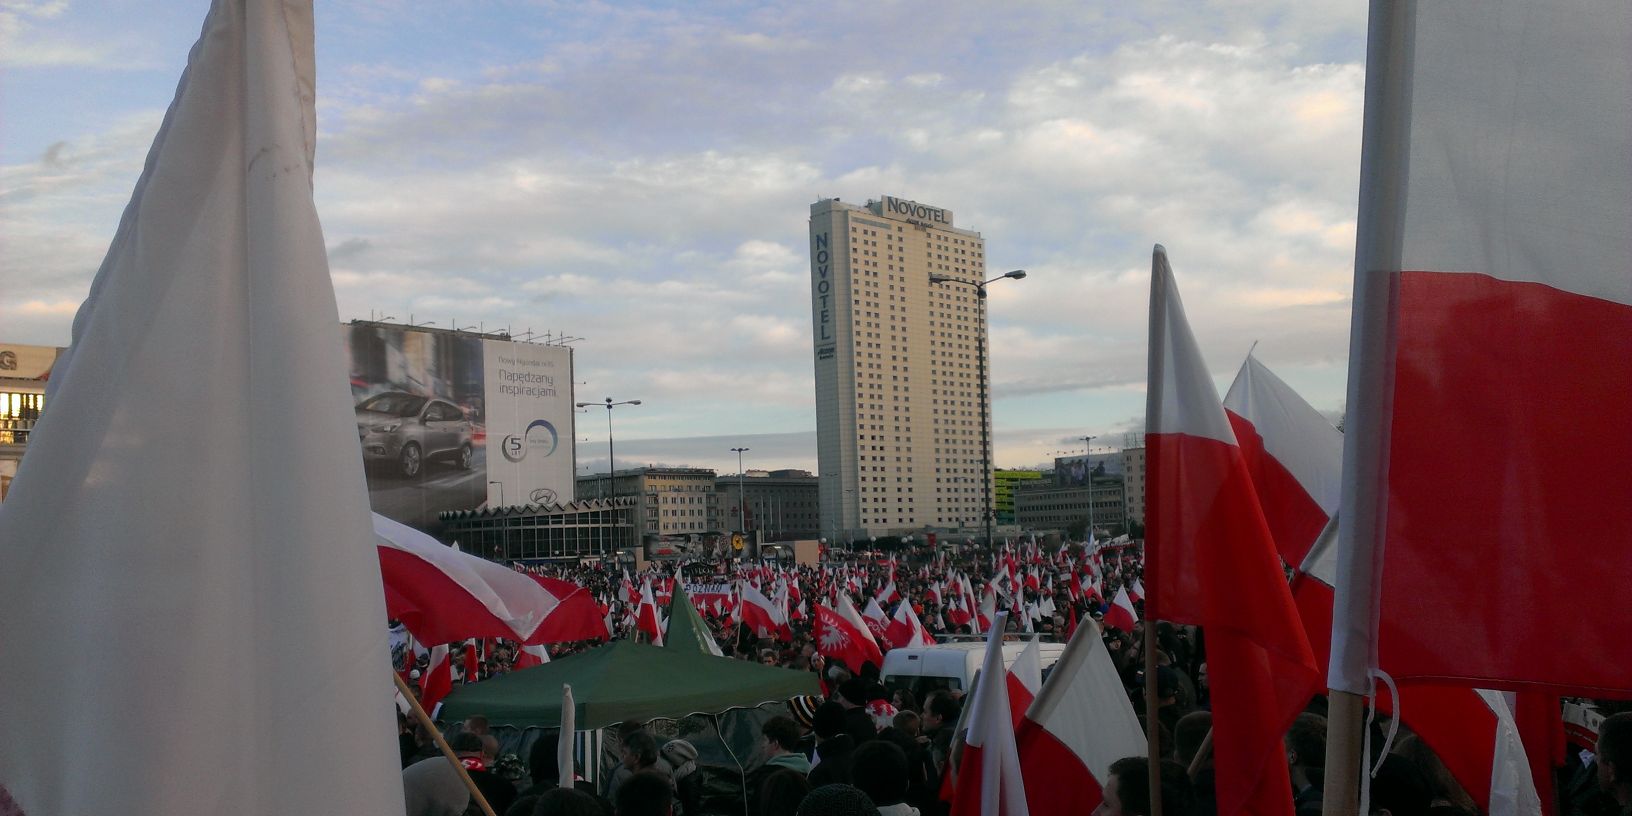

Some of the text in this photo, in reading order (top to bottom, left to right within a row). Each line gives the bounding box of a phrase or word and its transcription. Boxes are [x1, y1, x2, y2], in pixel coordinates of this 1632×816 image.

[887, 196, 949, 225] NOVOTEL
[815, 232, 831, 341] NOVOTEL
[498, 368, 554, 387] Napędzany
[510, 437, 522, 451] 5
